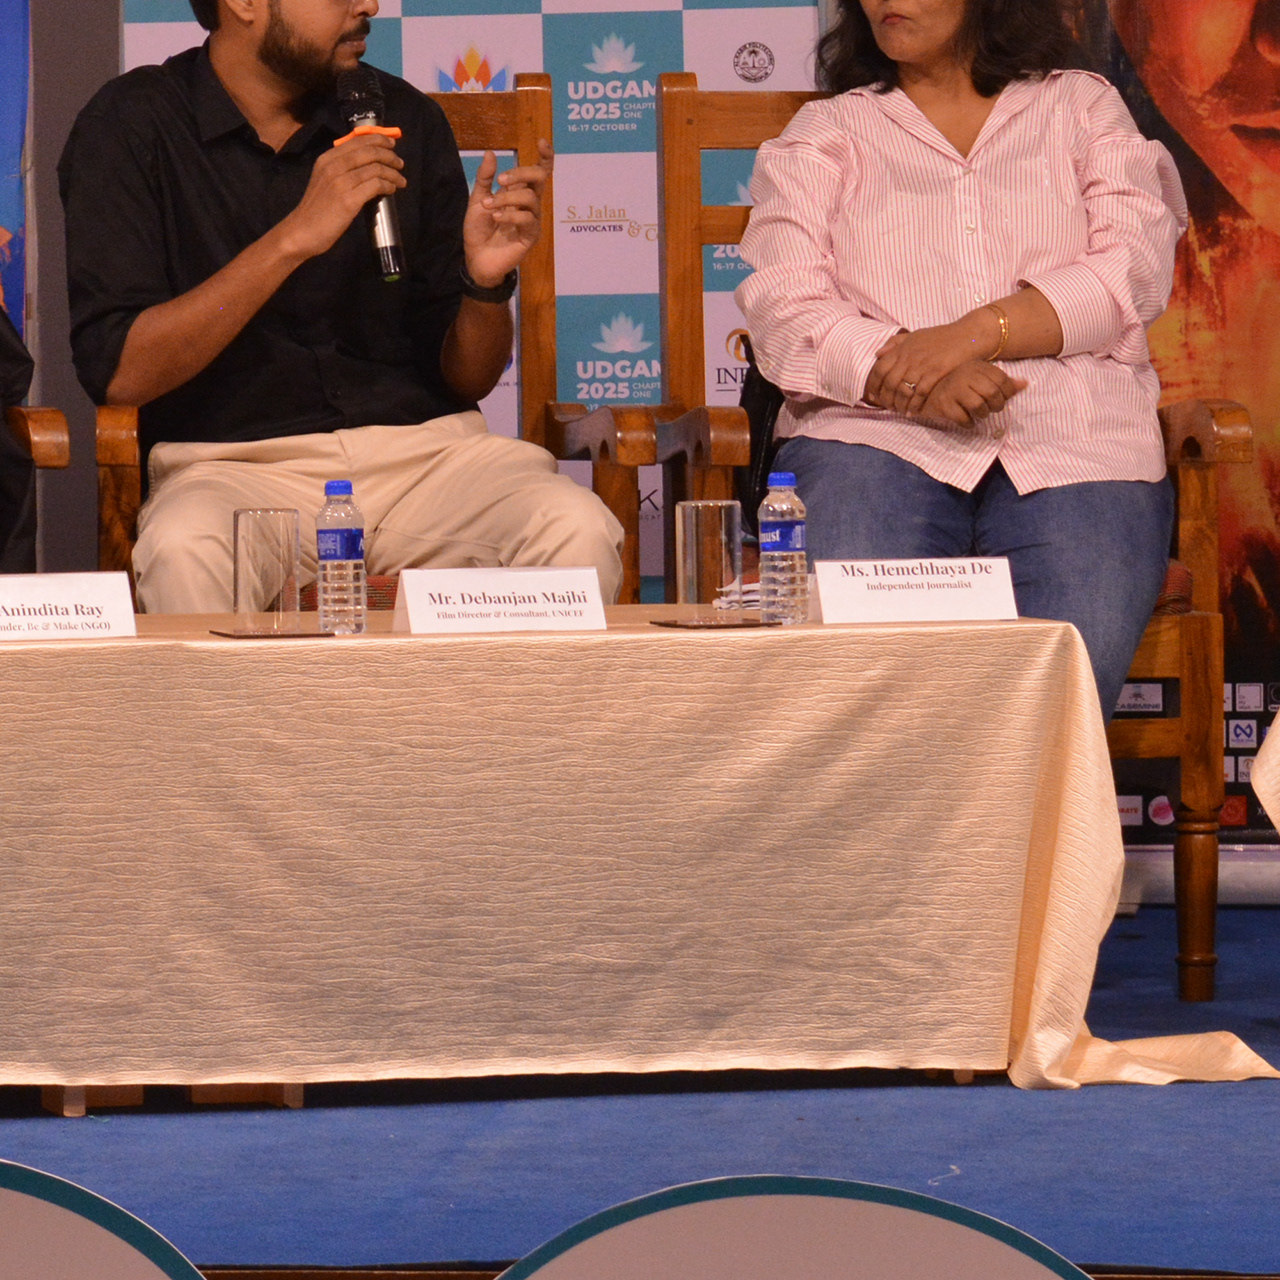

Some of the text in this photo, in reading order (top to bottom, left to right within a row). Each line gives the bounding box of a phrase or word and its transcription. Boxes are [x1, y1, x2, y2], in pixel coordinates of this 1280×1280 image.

[567, 205, 626, 220] S. Jalan
[841, 562, 992, 577] Ms. Hemchhaya De
[867, 581, 971, 591] Independent Journalist
[429, 591, 587, 606] Mr. Debanjan Majhi
[0, 603, 69, 617] Anindita
[74, 603, 103, 619] Ray
[552, 610, 585, 618] UNICEF
[53, 622, 78, 630] Make
[81, 622, 110, 630] (NGO)
